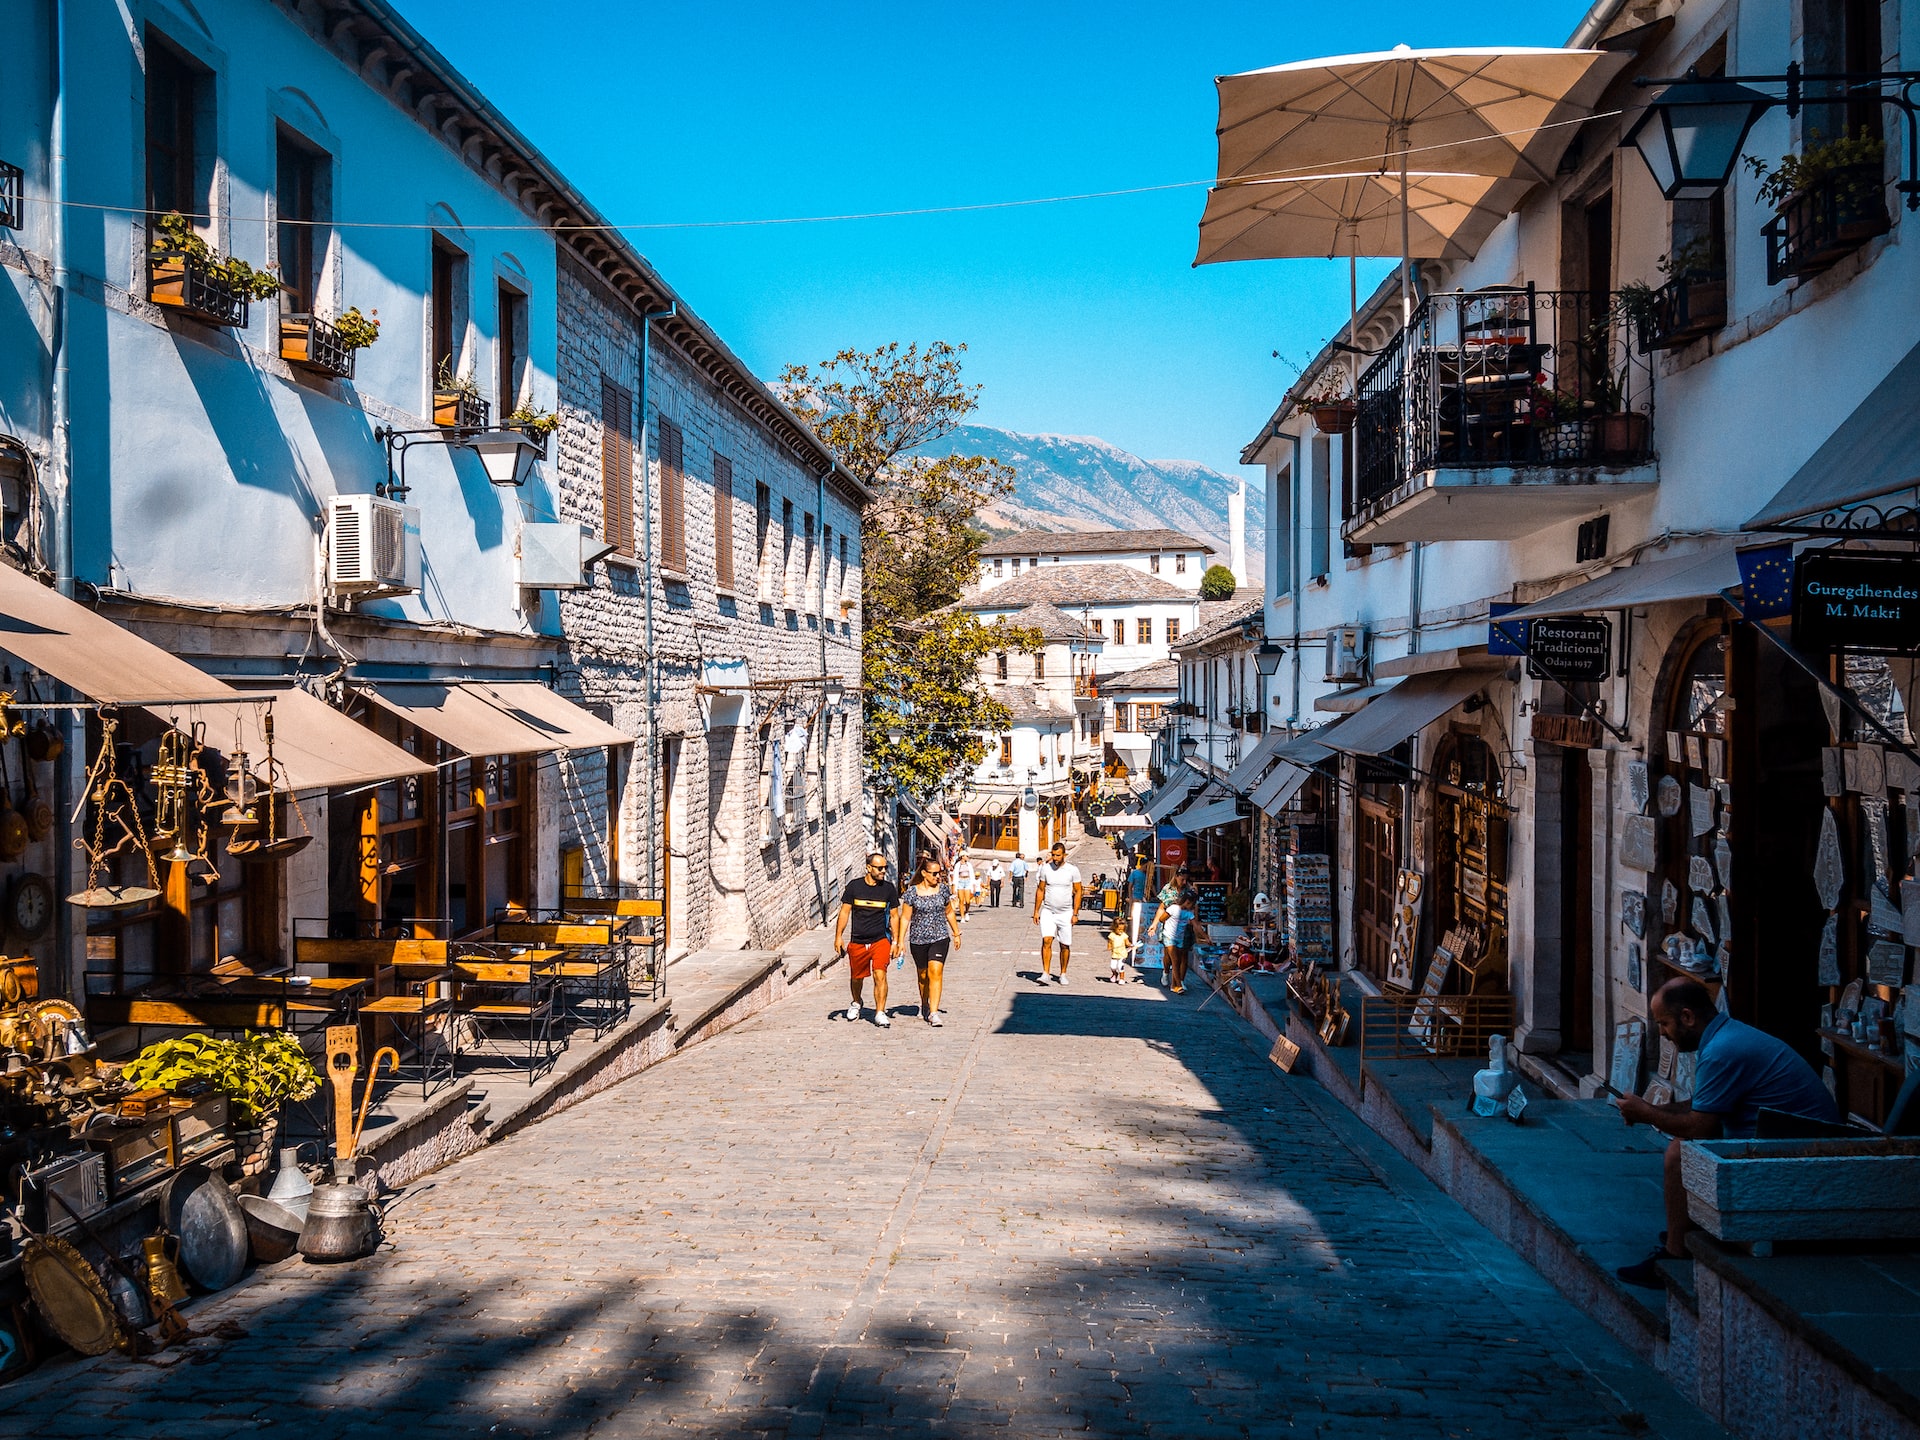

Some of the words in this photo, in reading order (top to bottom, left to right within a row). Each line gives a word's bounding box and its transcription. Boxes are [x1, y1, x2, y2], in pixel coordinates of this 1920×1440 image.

[1807, 581, 1918, 600] Guregdhendes
[1826, 603, 1847, 616] M.
[1853, 604, 1901, 619] Makri
[1538, 625, 1600, 640] Restorant
[1534, 640, 1604, 654] Tradicional
[1544, 656, 1572, 667] Odaja
[1574, 660, 1592, 669] 1937
